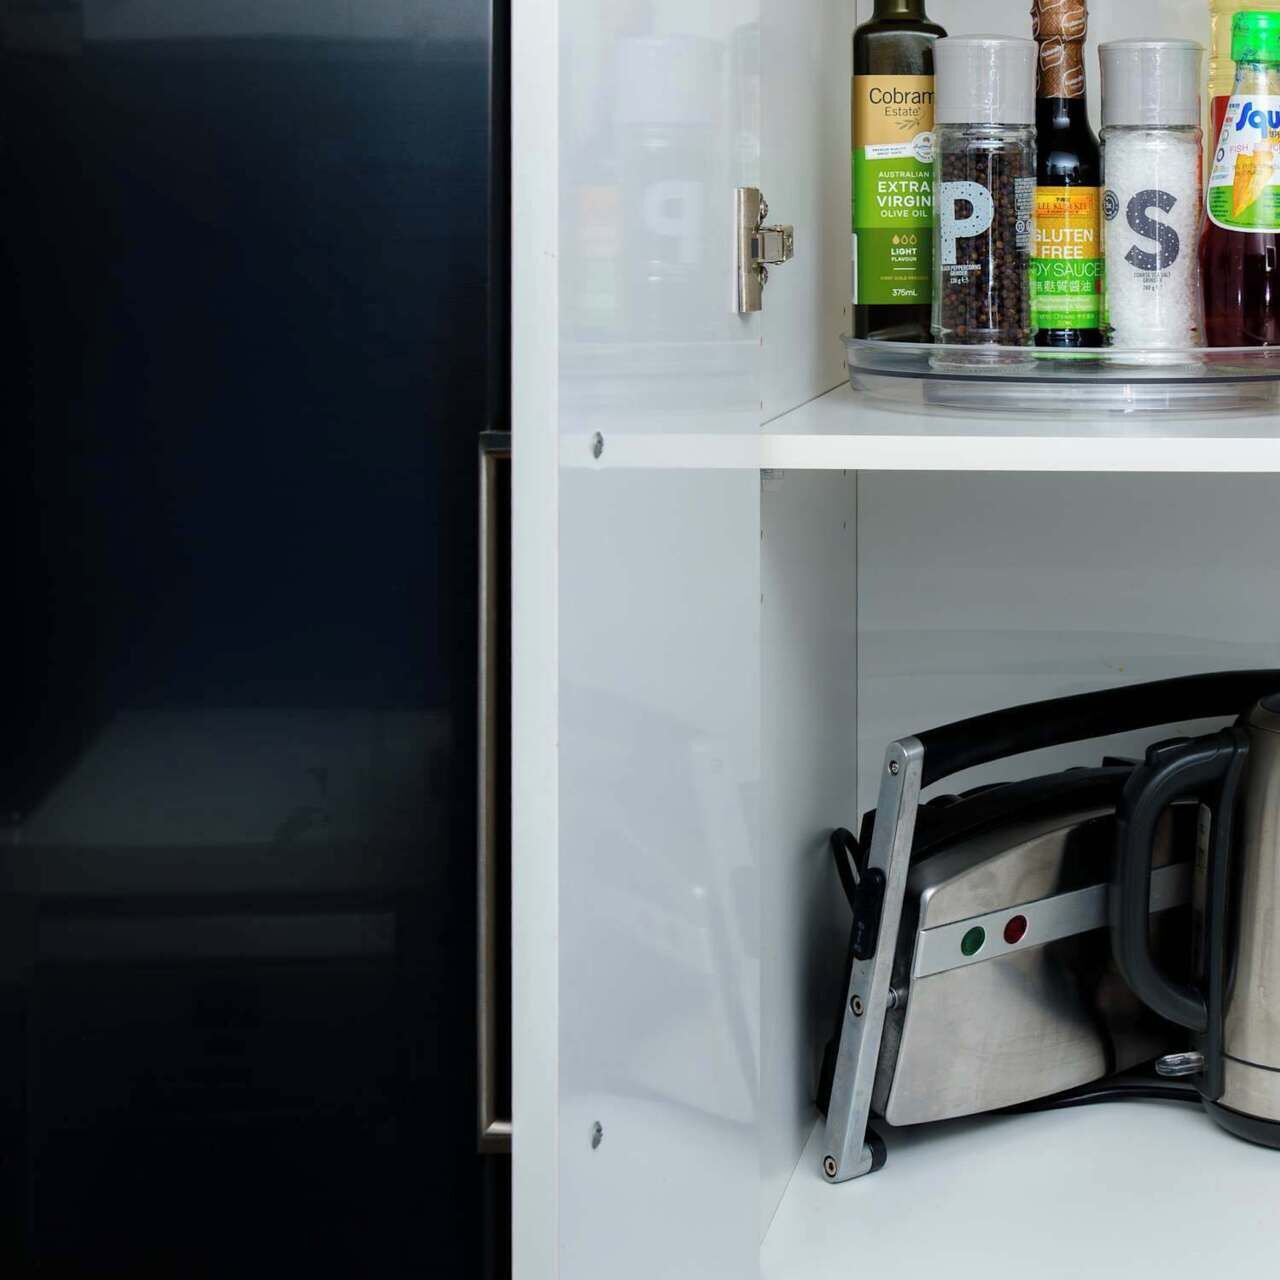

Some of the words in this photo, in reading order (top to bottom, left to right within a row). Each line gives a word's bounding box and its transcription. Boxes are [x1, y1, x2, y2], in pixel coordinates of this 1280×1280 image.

[884, 106, 920, 117] Estate
[878, 181, 930, 193] EXTRA
[877, 195, 932, 208] VIRGIN
[880, 210, 909, 218] OLIVE
[912, 210, 929, 218] OIL
[940, 181, 995, 265] P
[1033, 228, 1094, 242] GLUTEN
[1124, 189, 1179, 272] S
[1041, 245, 1084, 259] FREE
[1053, 262, 1102, 277] SAUCE
[891, 288, 917, 297] 375mL
